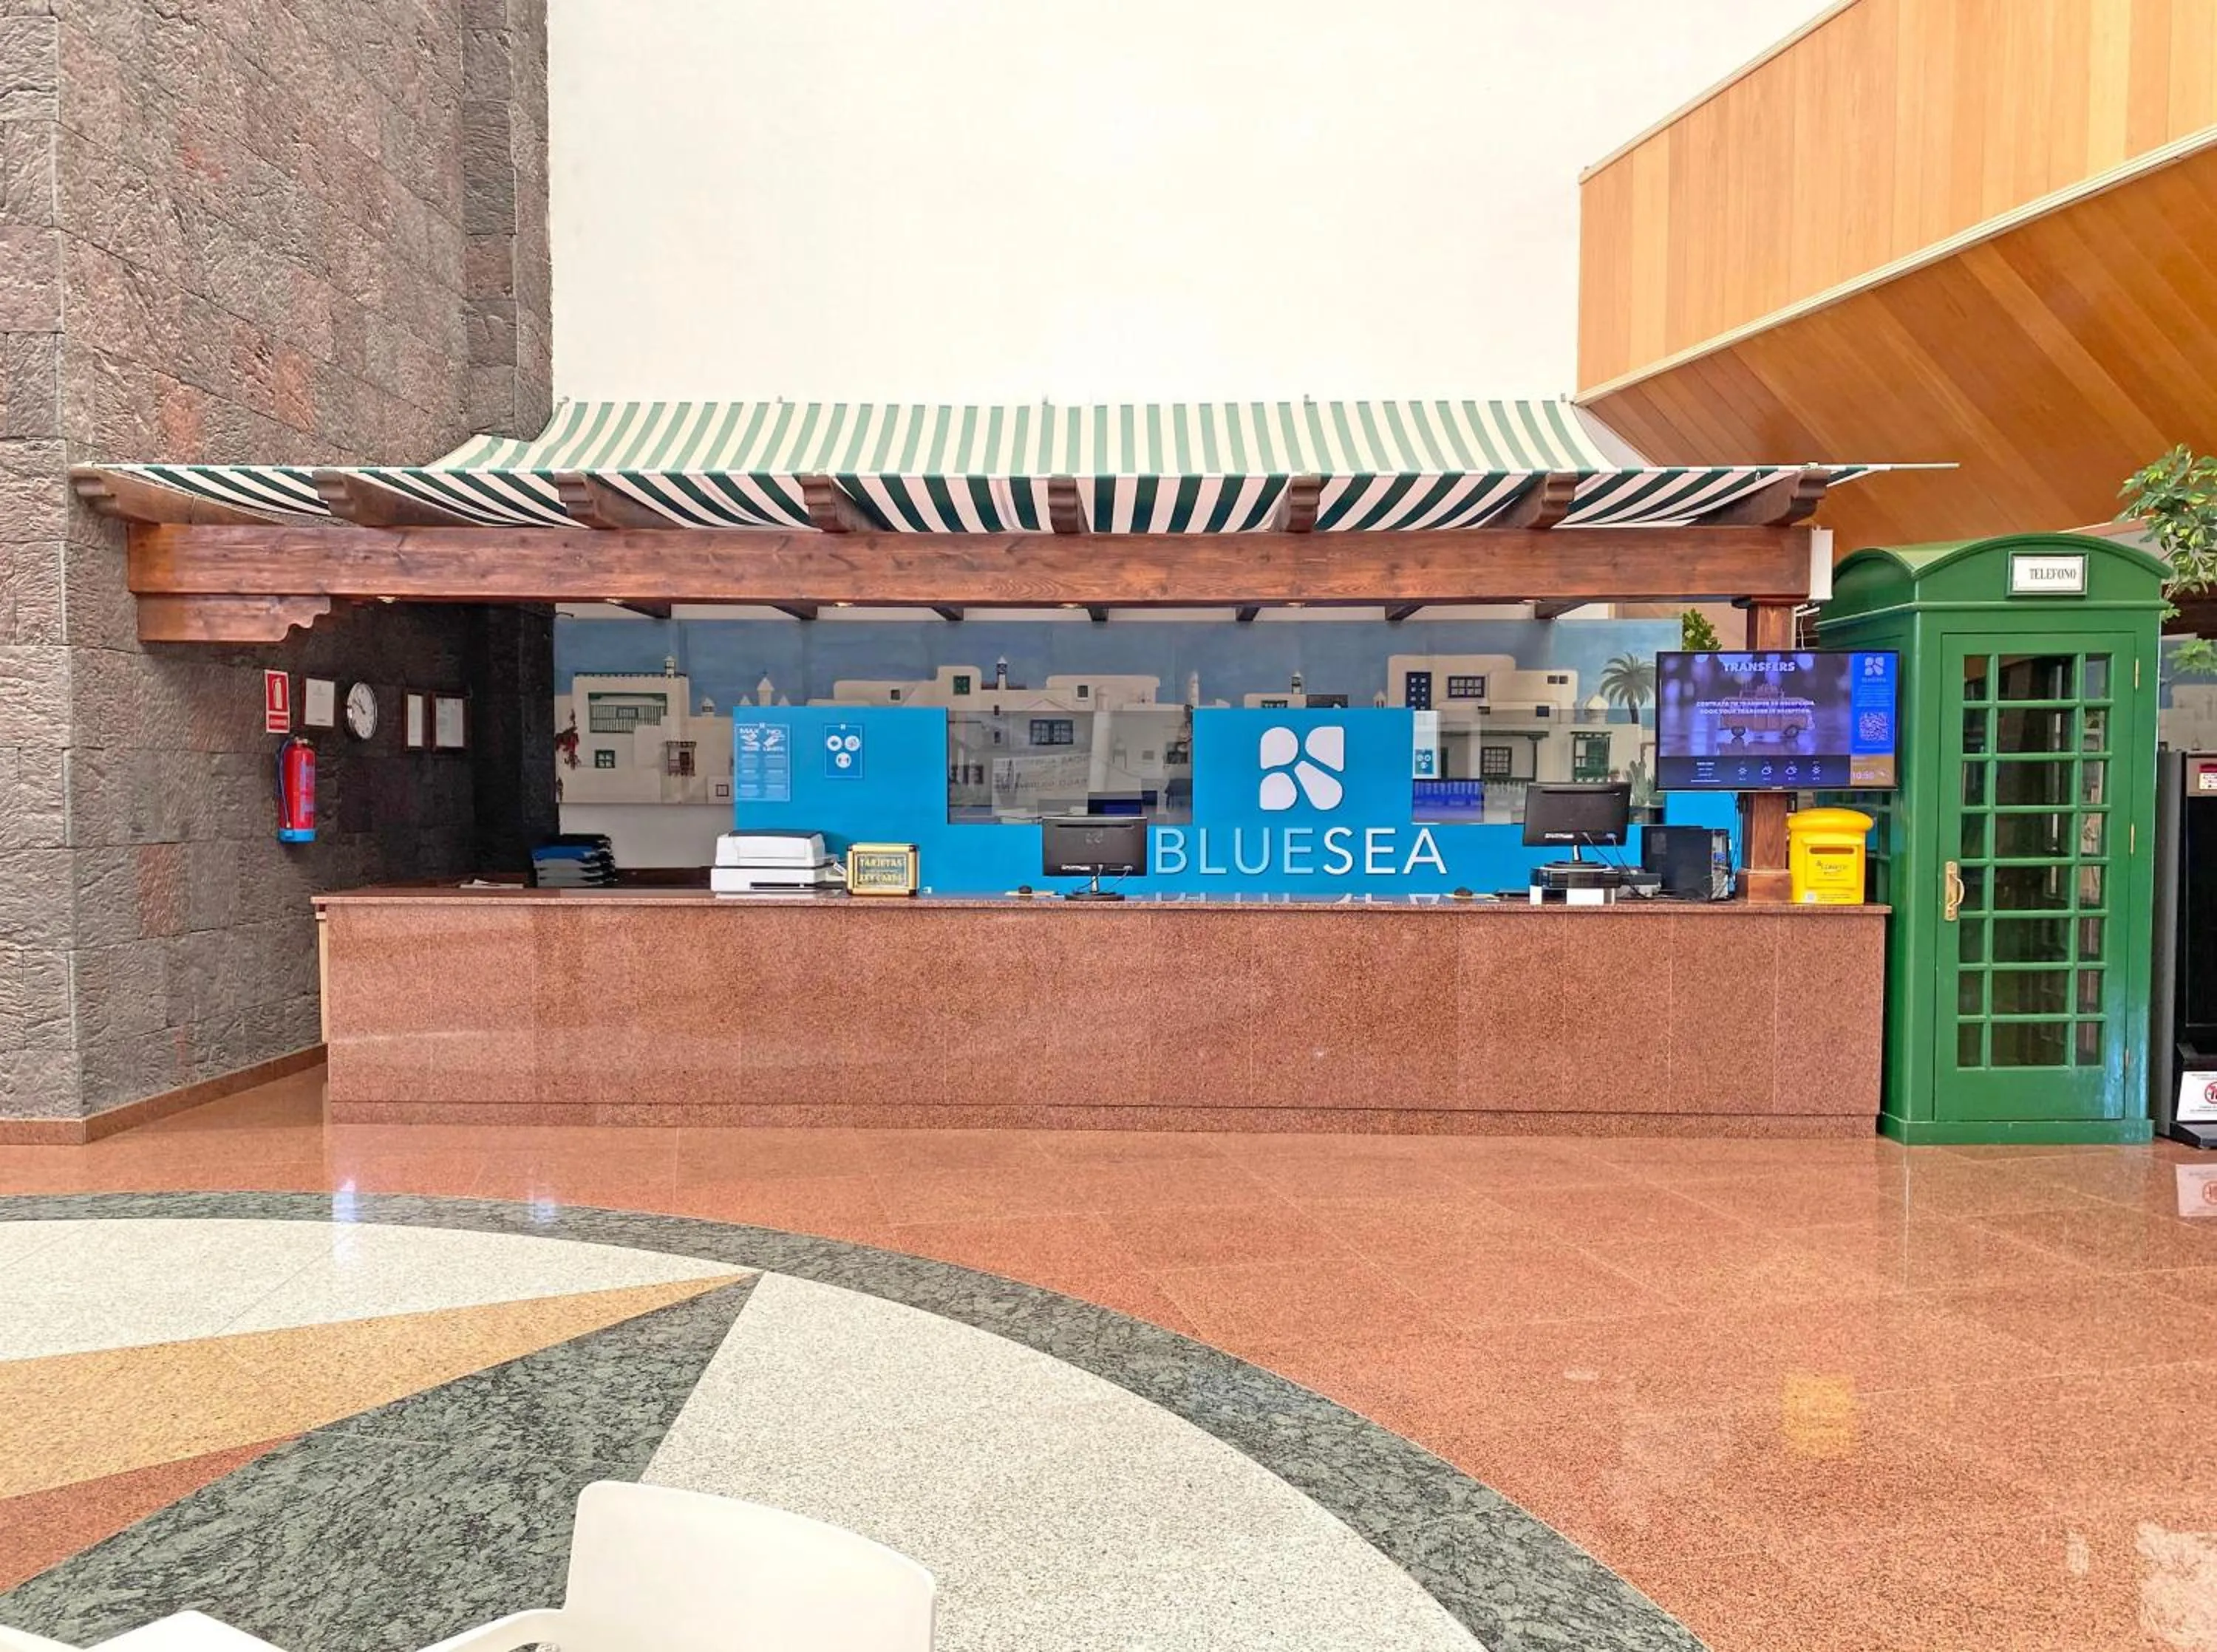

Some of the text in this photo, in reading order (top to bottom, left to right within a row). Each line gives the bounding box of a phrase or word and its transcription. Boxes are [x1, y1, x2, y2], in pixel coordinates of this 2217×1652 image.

[2029, 568, 2077, 580] TELEFONO
[1723, 662, 1796, 672] TRANSFERS
[1155, 827, 1448, 875] BLUESEA
